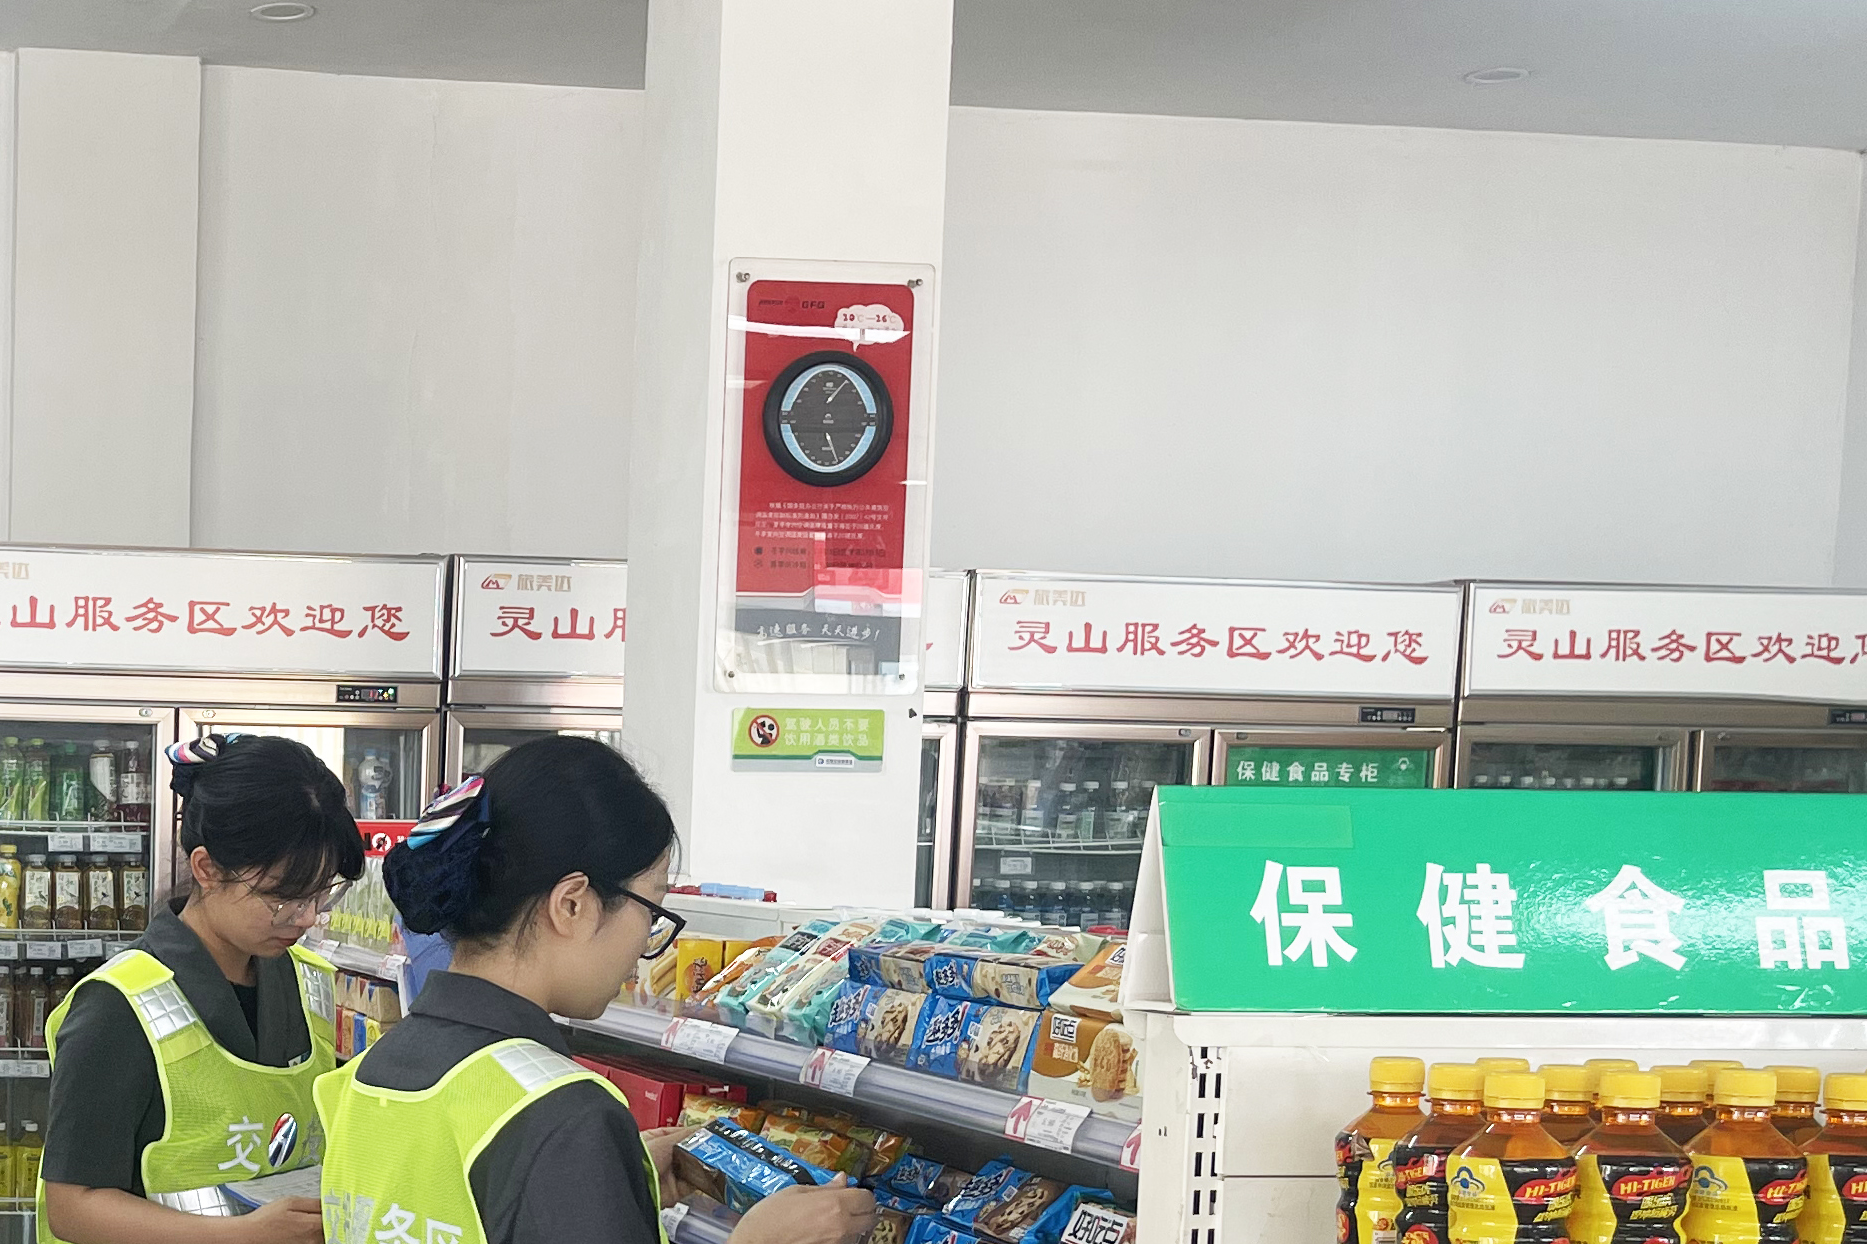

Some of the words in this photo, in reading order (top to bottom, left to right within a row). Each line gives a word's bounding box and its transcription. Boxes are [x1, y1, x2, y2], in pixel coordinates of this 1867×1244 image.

[1006, 619, 1430, 666] 灵山服务区欢迎您
[784, 717, 871, 732] 驾驶人员不要
[784, 732, 870, 747] 饮用酒类饮品
[1235, 760, 1380, 785] 保健食品专柜
[1250, 858, 1852, 973] 保健食品
[218, 1115, 265, 1173] 交
[1619, 1176, 1677, 1196] HI-TIGER
